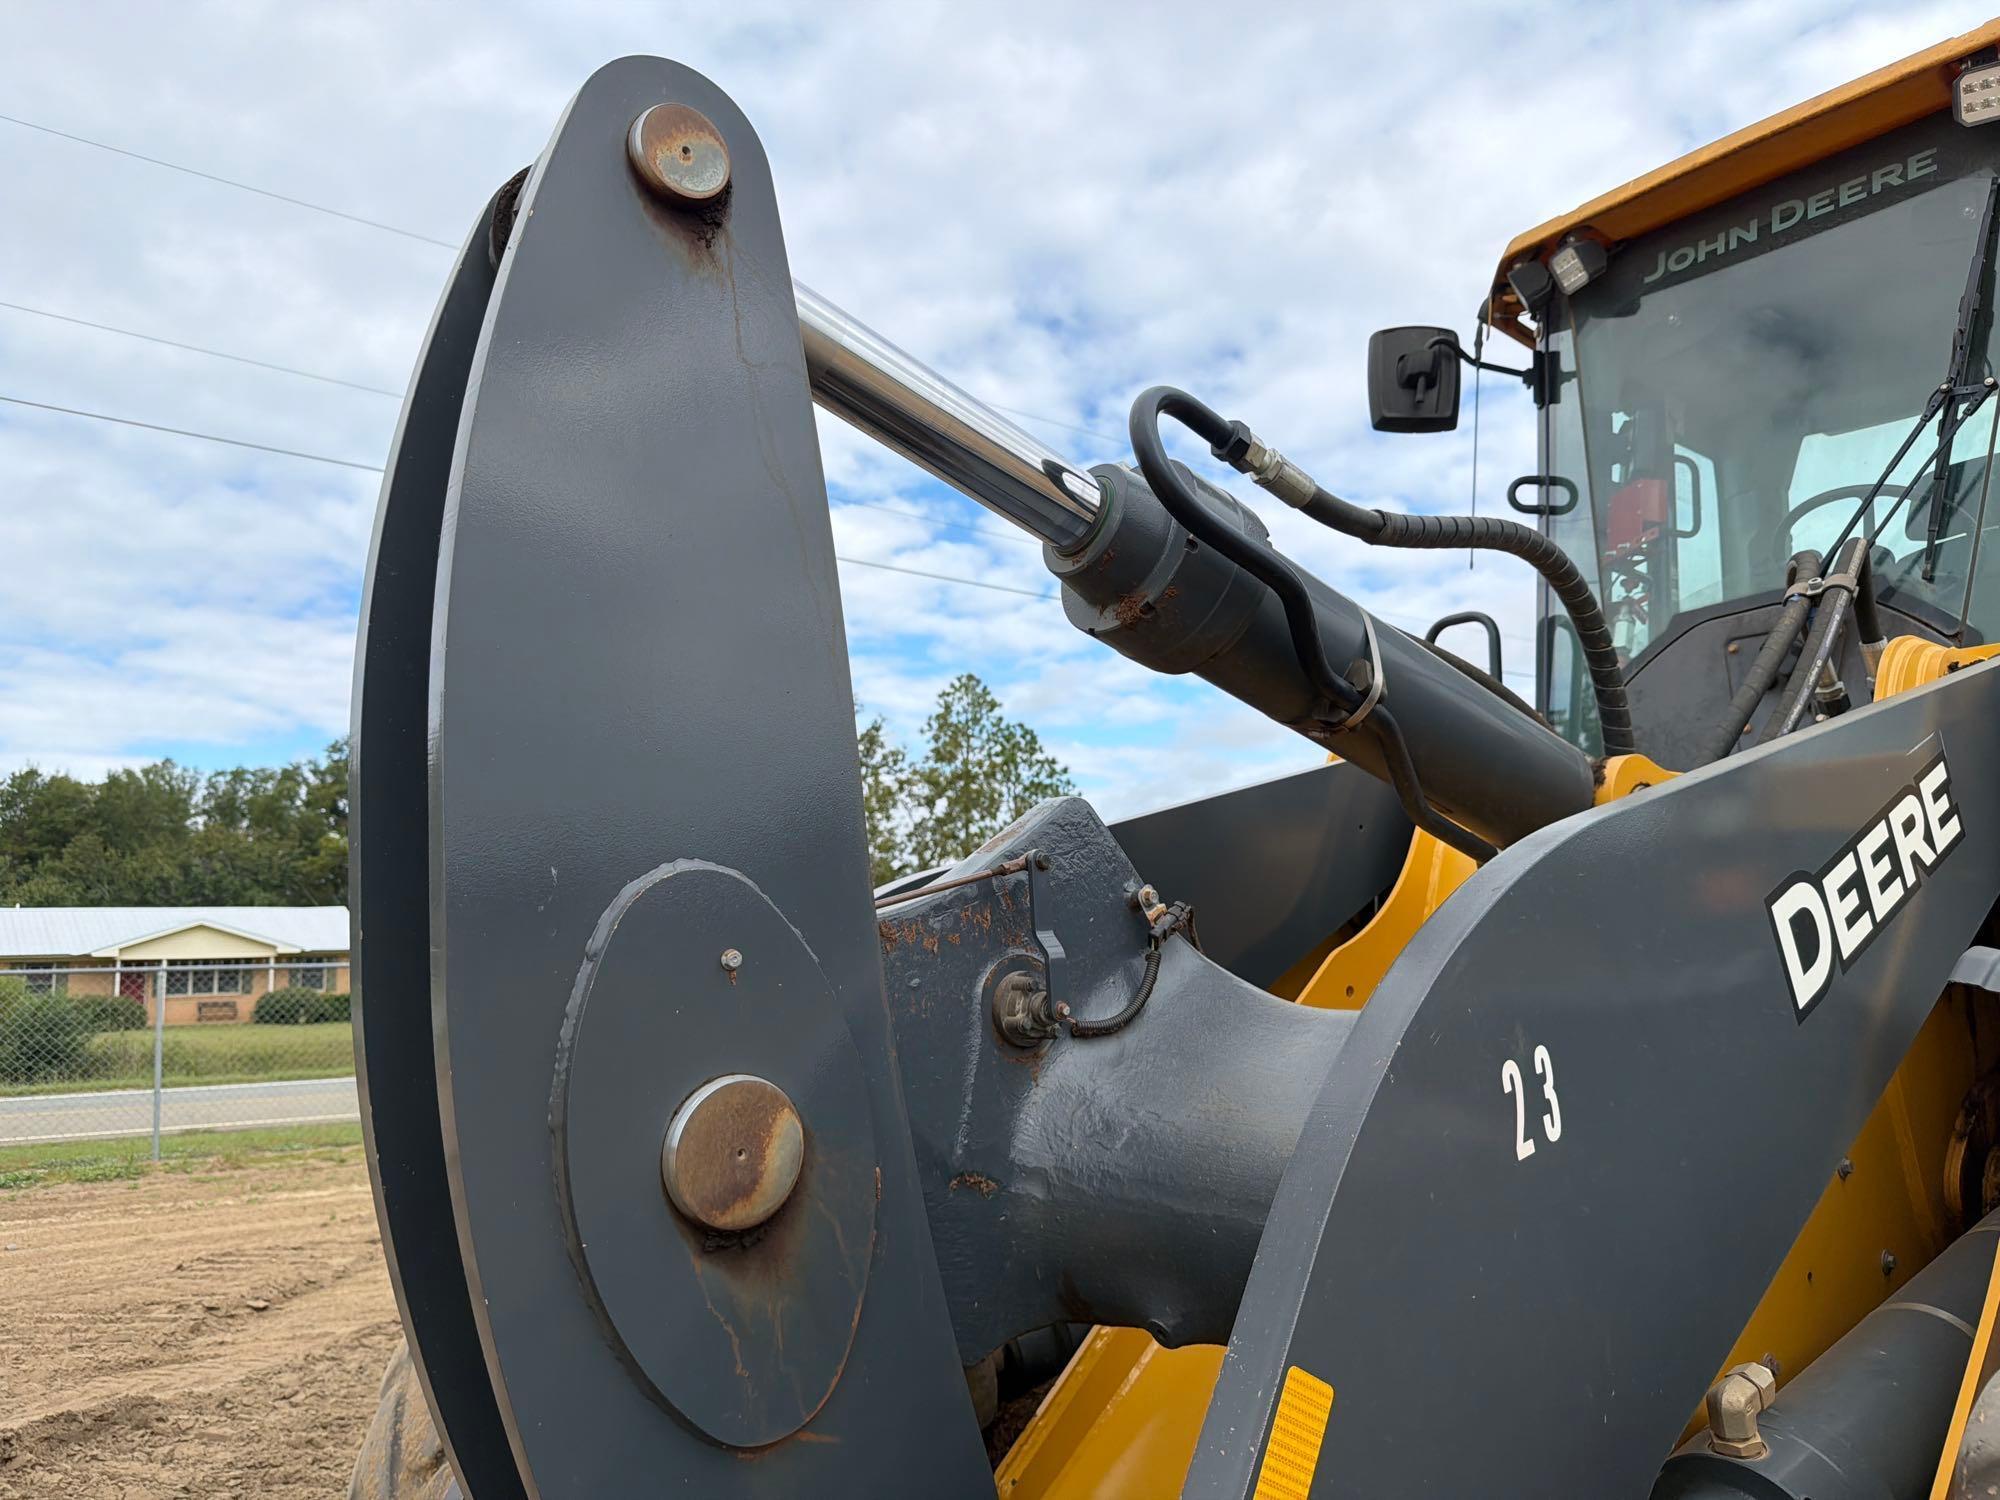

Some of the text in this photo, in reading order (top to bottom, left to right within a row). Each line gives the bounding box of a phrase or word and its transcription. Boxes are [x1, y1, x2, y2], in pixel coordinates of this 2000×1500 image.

[1643, 147, 1938, 284] JOHN DEERE
[1771, 761, 1961, 1010] DEERE
